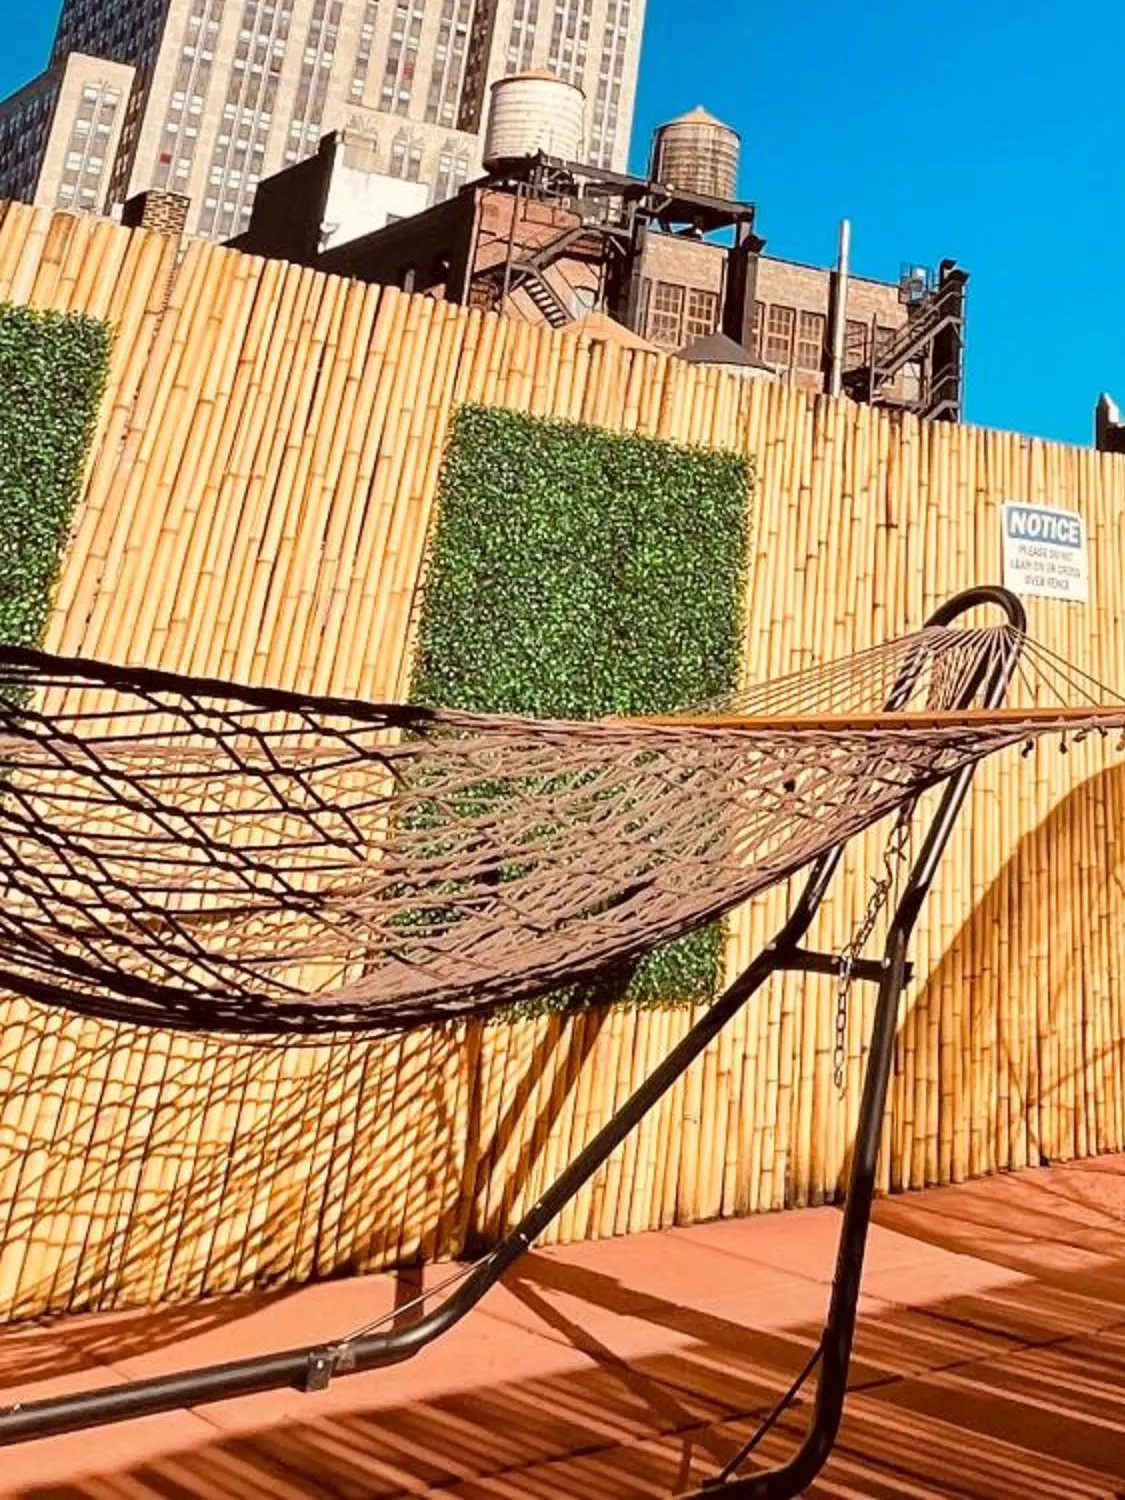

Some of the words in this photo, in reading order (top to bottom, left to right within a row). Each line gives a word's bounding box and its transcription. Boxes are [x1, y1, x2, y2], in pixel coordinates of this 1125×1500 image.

[1009, 510, 1080, 543] NOTICE
[1018, 545, 1048, 558] PLEASE
[1010, 559, 1031, 571] LEAN
[1025, 575, 1044, 587] OVER
